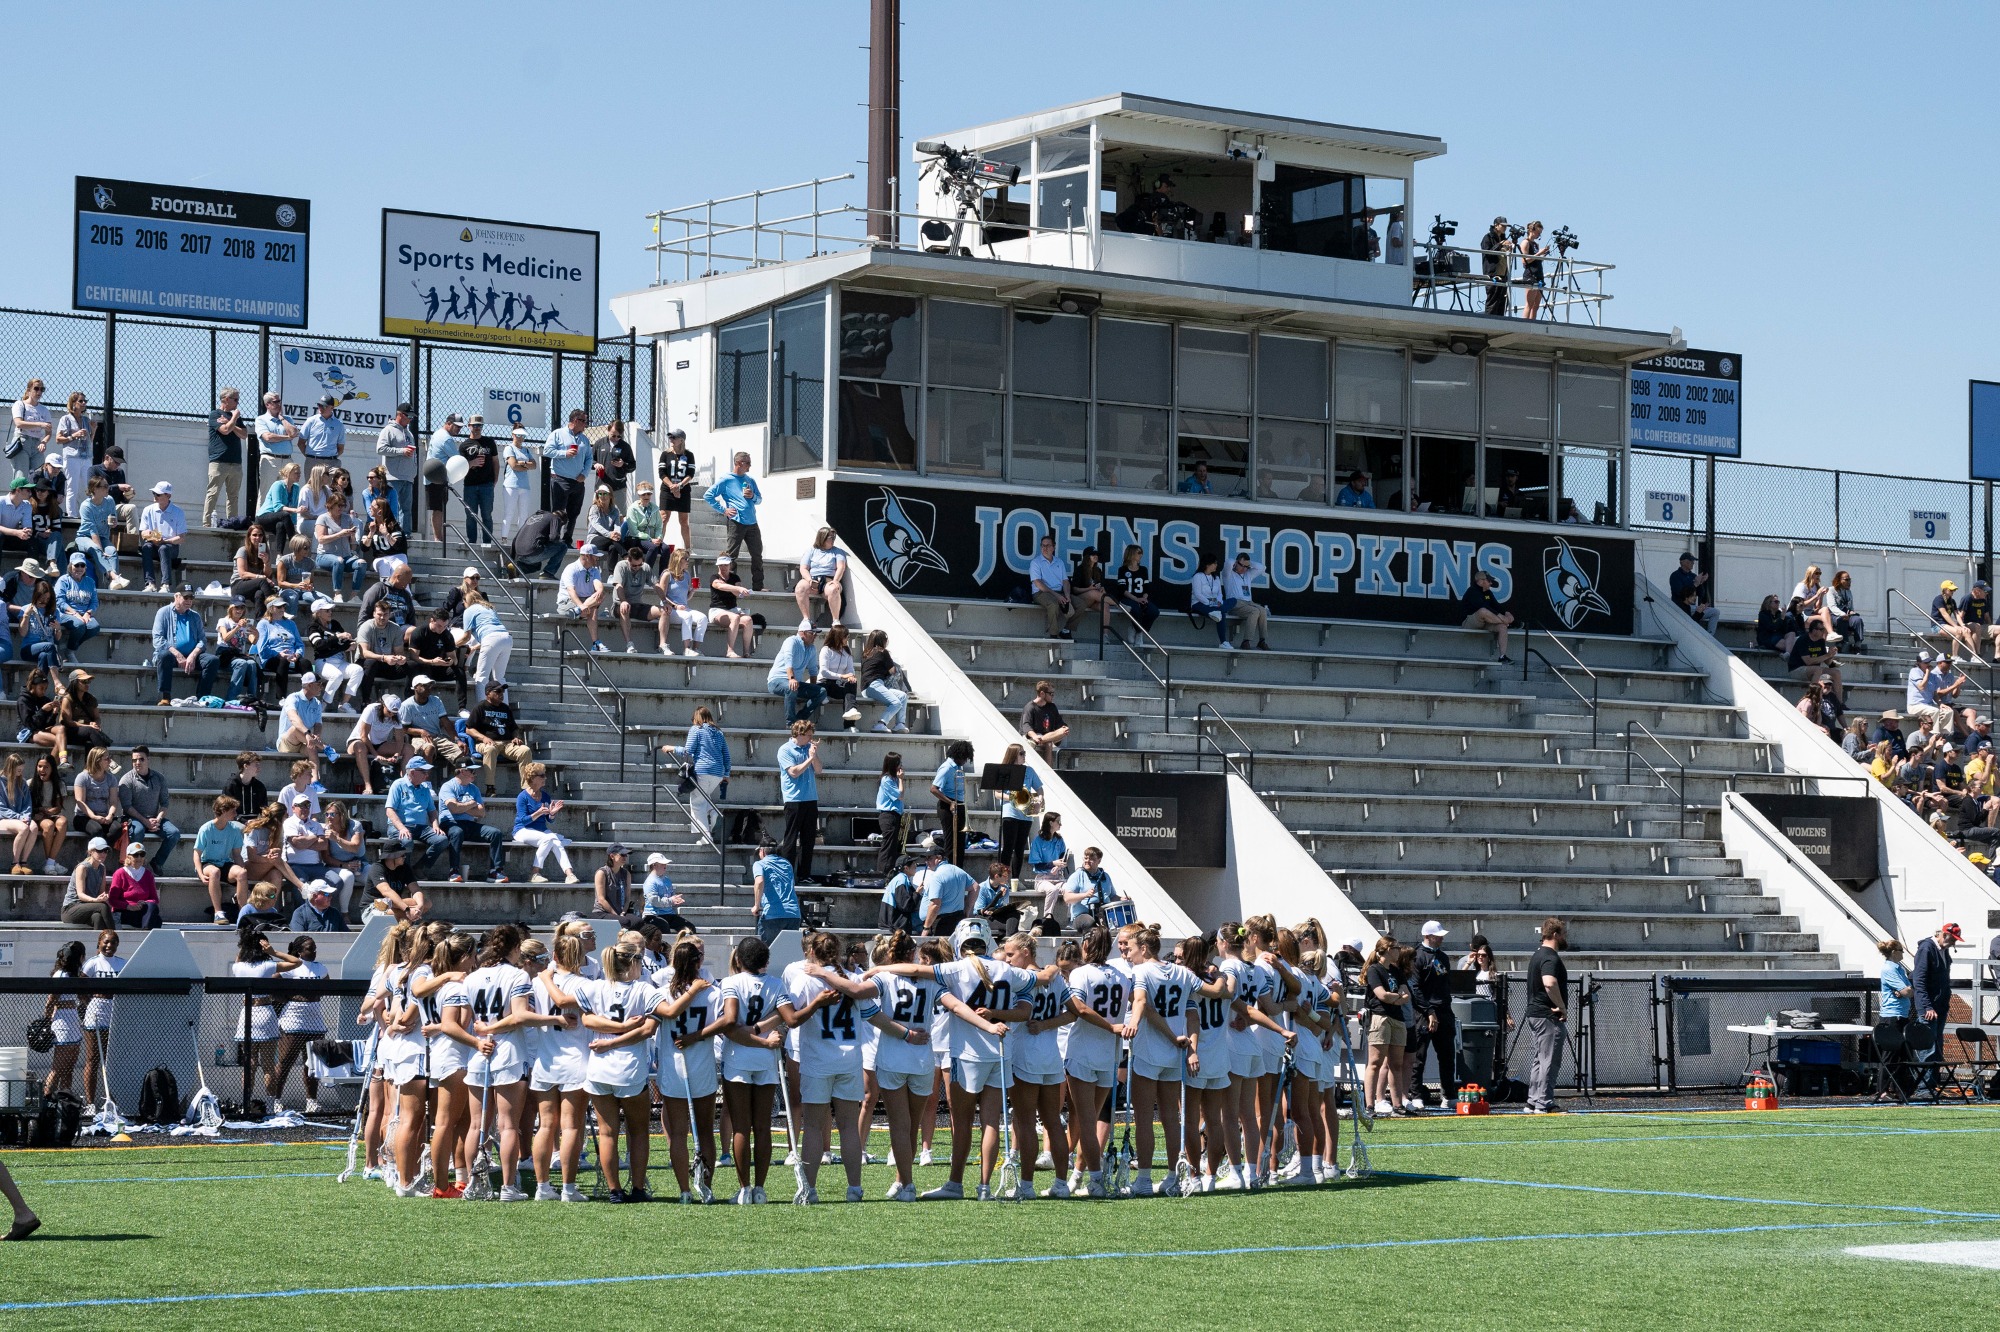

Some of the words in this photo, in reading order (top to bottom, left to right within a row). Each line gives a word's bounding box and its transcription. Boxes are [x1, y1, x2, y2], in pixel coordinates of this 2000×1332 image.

[150, 196, 237, 219] FOOTBALL
[90, 224, 123, 246] 2015
[135, 228, 168, 250] 2016
[180, 233, 212, 255] 2017
[223, 237, 255, 259] 2018
[264, 242, 296, 263] 2021
[475, 228, 496, 240] JOHNS
[496, 231, 525, 242] HOPKINS
[398, 244, 474, 271] Sports
[482, 252, 582, 281] Medicine
[85, 285, 155, 306] CENTENNIAL
[159, 291, 231, 312] CONFERENCE
[234, 298, 300, 318] CHAMPIONS
[413, 326, 512, 342] hopkinsmedicine.org/sports
[518, 336, 566, 347] 410-847-3735
[304, 350, 375, 369] SENIORS
[1664, 356, 1705, 371] SOCCER
[489, 389, 541, 403] SECTION
[1658, 382, 1681, 400] 2000
[1686, 385, 1708, 402] 2002
[1712, 388, 1735, 405] 2004
[283, 404, 308, 417] WE
[507, 403, 522, 424] 6
[1630, 402, 1651, 420] 2007
[1658, 405, 1681, 423] 2009
[1685, 408, 1706, 425] 2019
[1644, 429, 1691, 445] CONFERENCE
[1692, 434, 1735, 449] CHAMPIONS
[670, 459, 687, 477] 15
[1649, 492, 1686, 502] SECTION
[1662, 502, 1673, 521] 8
[1913, 511, 1947, 520] SECTION
[1924, 520, 1935, 539] 9
[971, 505, 1199, 586] JOHNS
[1218, 524, 1511, 604] HOPKINS
[1126, 577, 1143, 593] 13
[1130, 807, 1162, 819] MENS
[1116, 826, 1176, 838] RESTROOM
[1786, 826, 1827, 837] WOMENS
[473, 987, 504, 1022] 44
[745, 995, 765, 1026] 8
[892, 988, 926, 1023] 21
[965, 979, 1011, 1024] 40
[1030, 992, 1057, 1022] 20
[1092, 983, 1123, 1018] 28
[1153, 984, 1182, 1017] 42
[670, 1006, 708, 1041] 37
[820, 993, 856, 1040] 14
[1197, 997, 1224, 1031] 10
[1462, 1104, 1469, 1114] G
[1752, 1101, 1759, 1110] G
